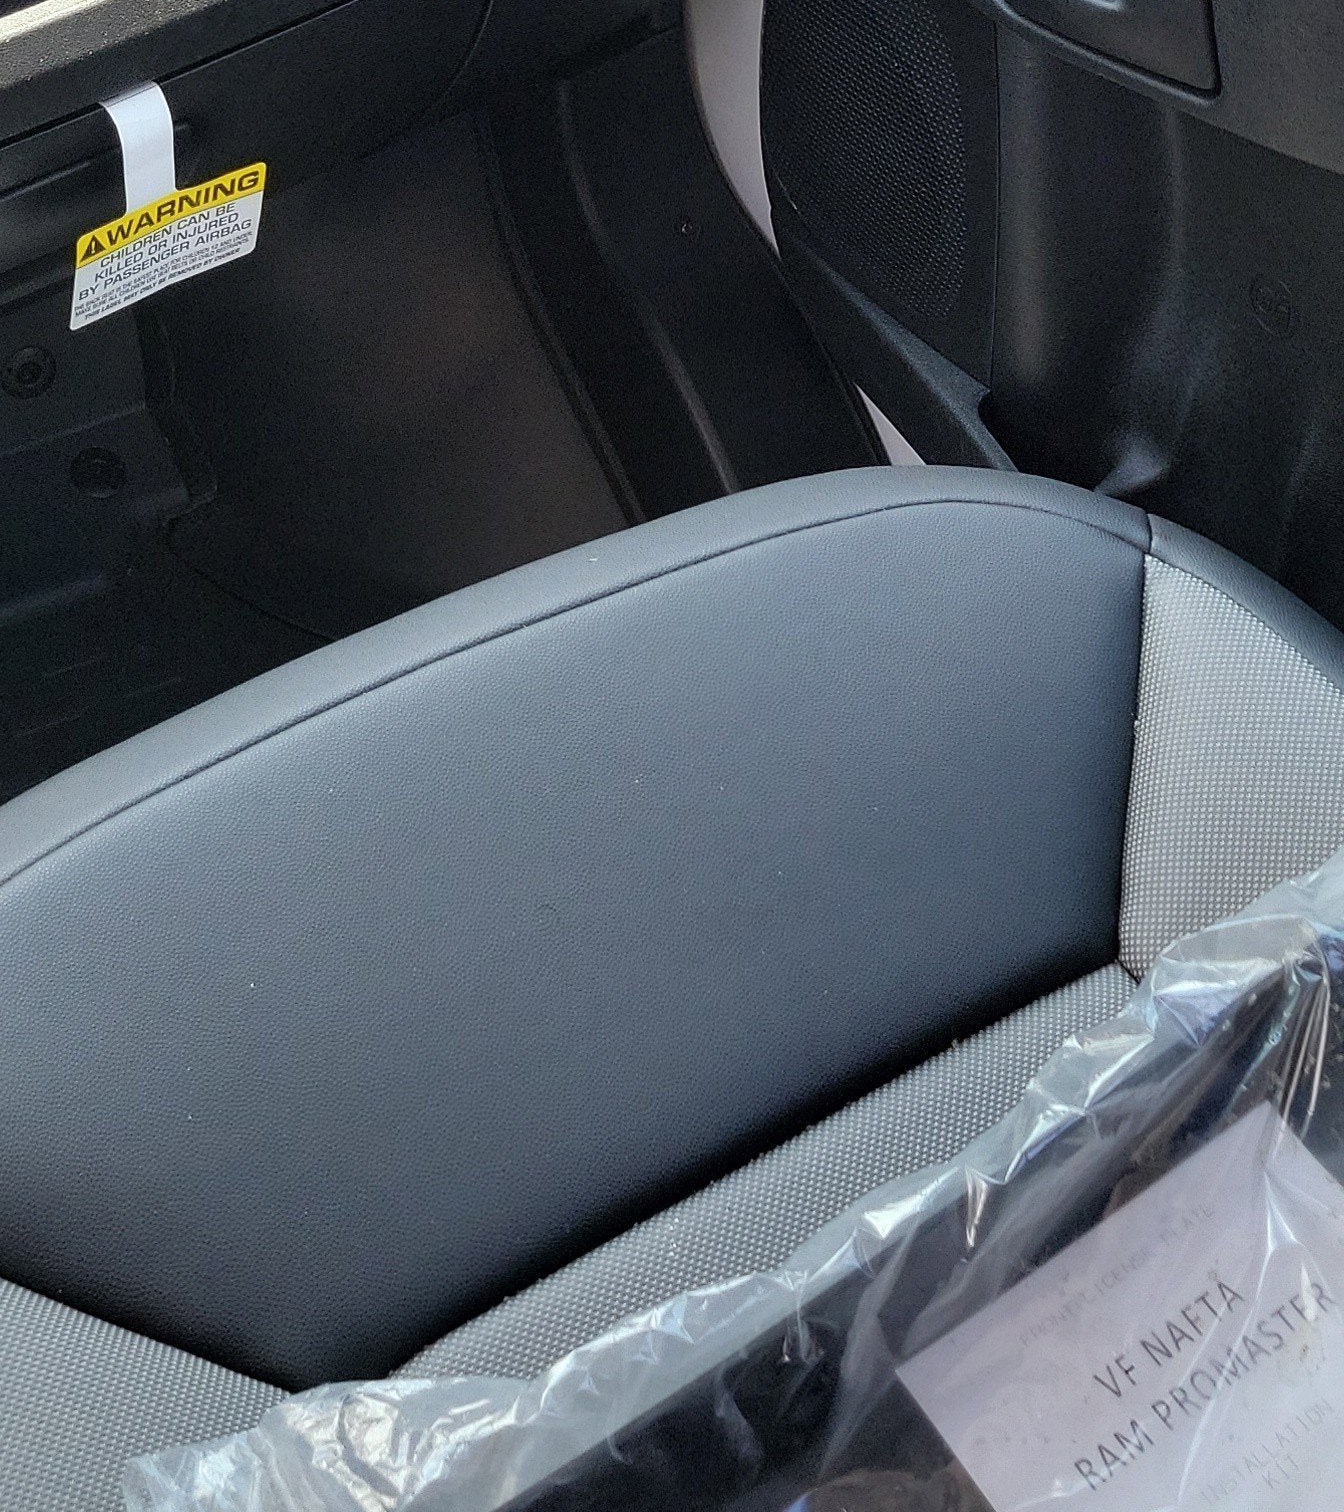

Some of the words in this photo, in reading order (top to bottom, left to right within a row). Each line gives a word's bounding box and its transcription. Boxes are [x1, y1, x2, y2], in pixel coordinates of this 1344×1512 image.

[100, 225, 173, 268] CHILDREN
[176, 211, 210, 231] CAN
[216, 202, 236, 218] BE
[106, 170, 260, 247] WARNING
[79, 283, 99, 301] BY
[103, 241, 190, 290] PASSENGER
[194, 219, 252, 248] AIRBAG
[94, 251, 144, 283] KILLED
[148, 239, 168, 256] OR
[172, 213, 239, 244] INJURED
[1093, 1352, 1137, 1398] VF
[1139, 1281, 1245, 1367] NAFTA
[1073, 1419, 1155, 1491] RAM
[1150, 1282, 1336, 1431] PROMASTER
[1261, 1455, 1300, 1489] KIT
